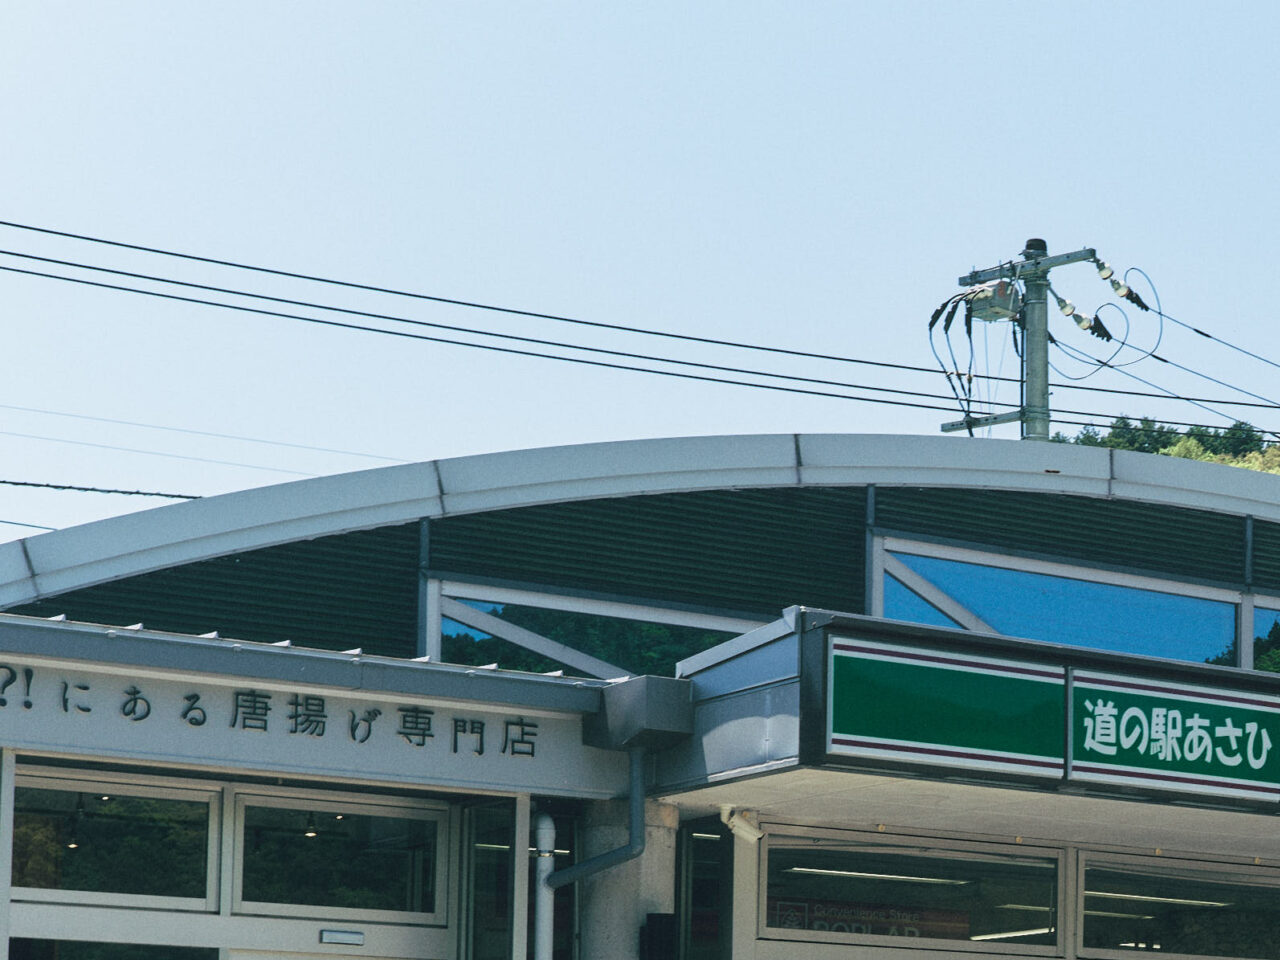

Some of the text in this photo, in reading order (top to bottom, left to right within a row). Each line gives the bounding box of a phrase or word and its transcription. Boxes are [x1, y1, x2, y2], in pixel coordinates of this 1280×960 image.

[1083, 698, 1273, 770] 道の駅あさひ
[889, 909, 921, 923] Store
